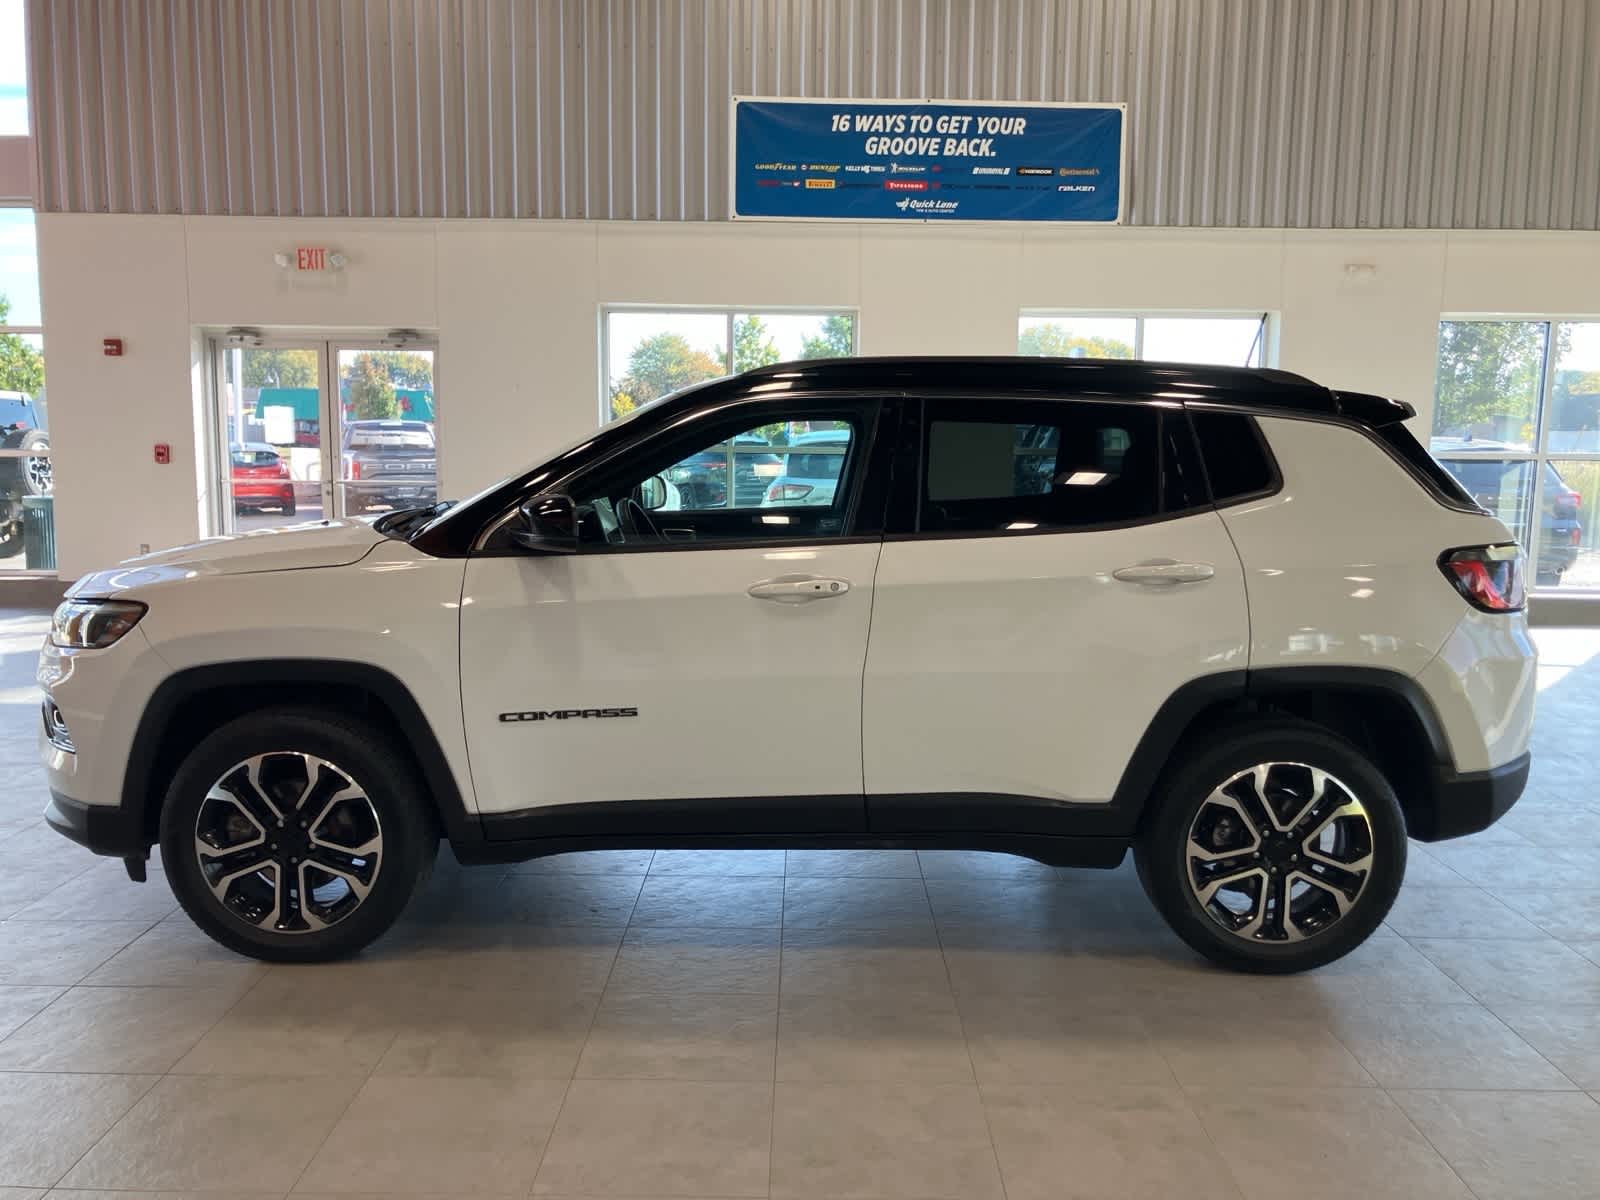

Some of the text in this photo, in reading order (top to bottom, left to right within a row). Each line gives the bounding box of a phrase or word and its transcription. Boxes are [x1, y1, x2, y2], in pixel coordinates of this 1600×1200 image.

[831, 114, 1027, 135] 16 WAYS TO GET YOUR
[865, 136, 997, 157] GROOVE BACK.
[909, 199, 959, 209] Quick Lane
[296, 247, 328, 271] EXIT
[498, 707, 639, 722] COMPASS
